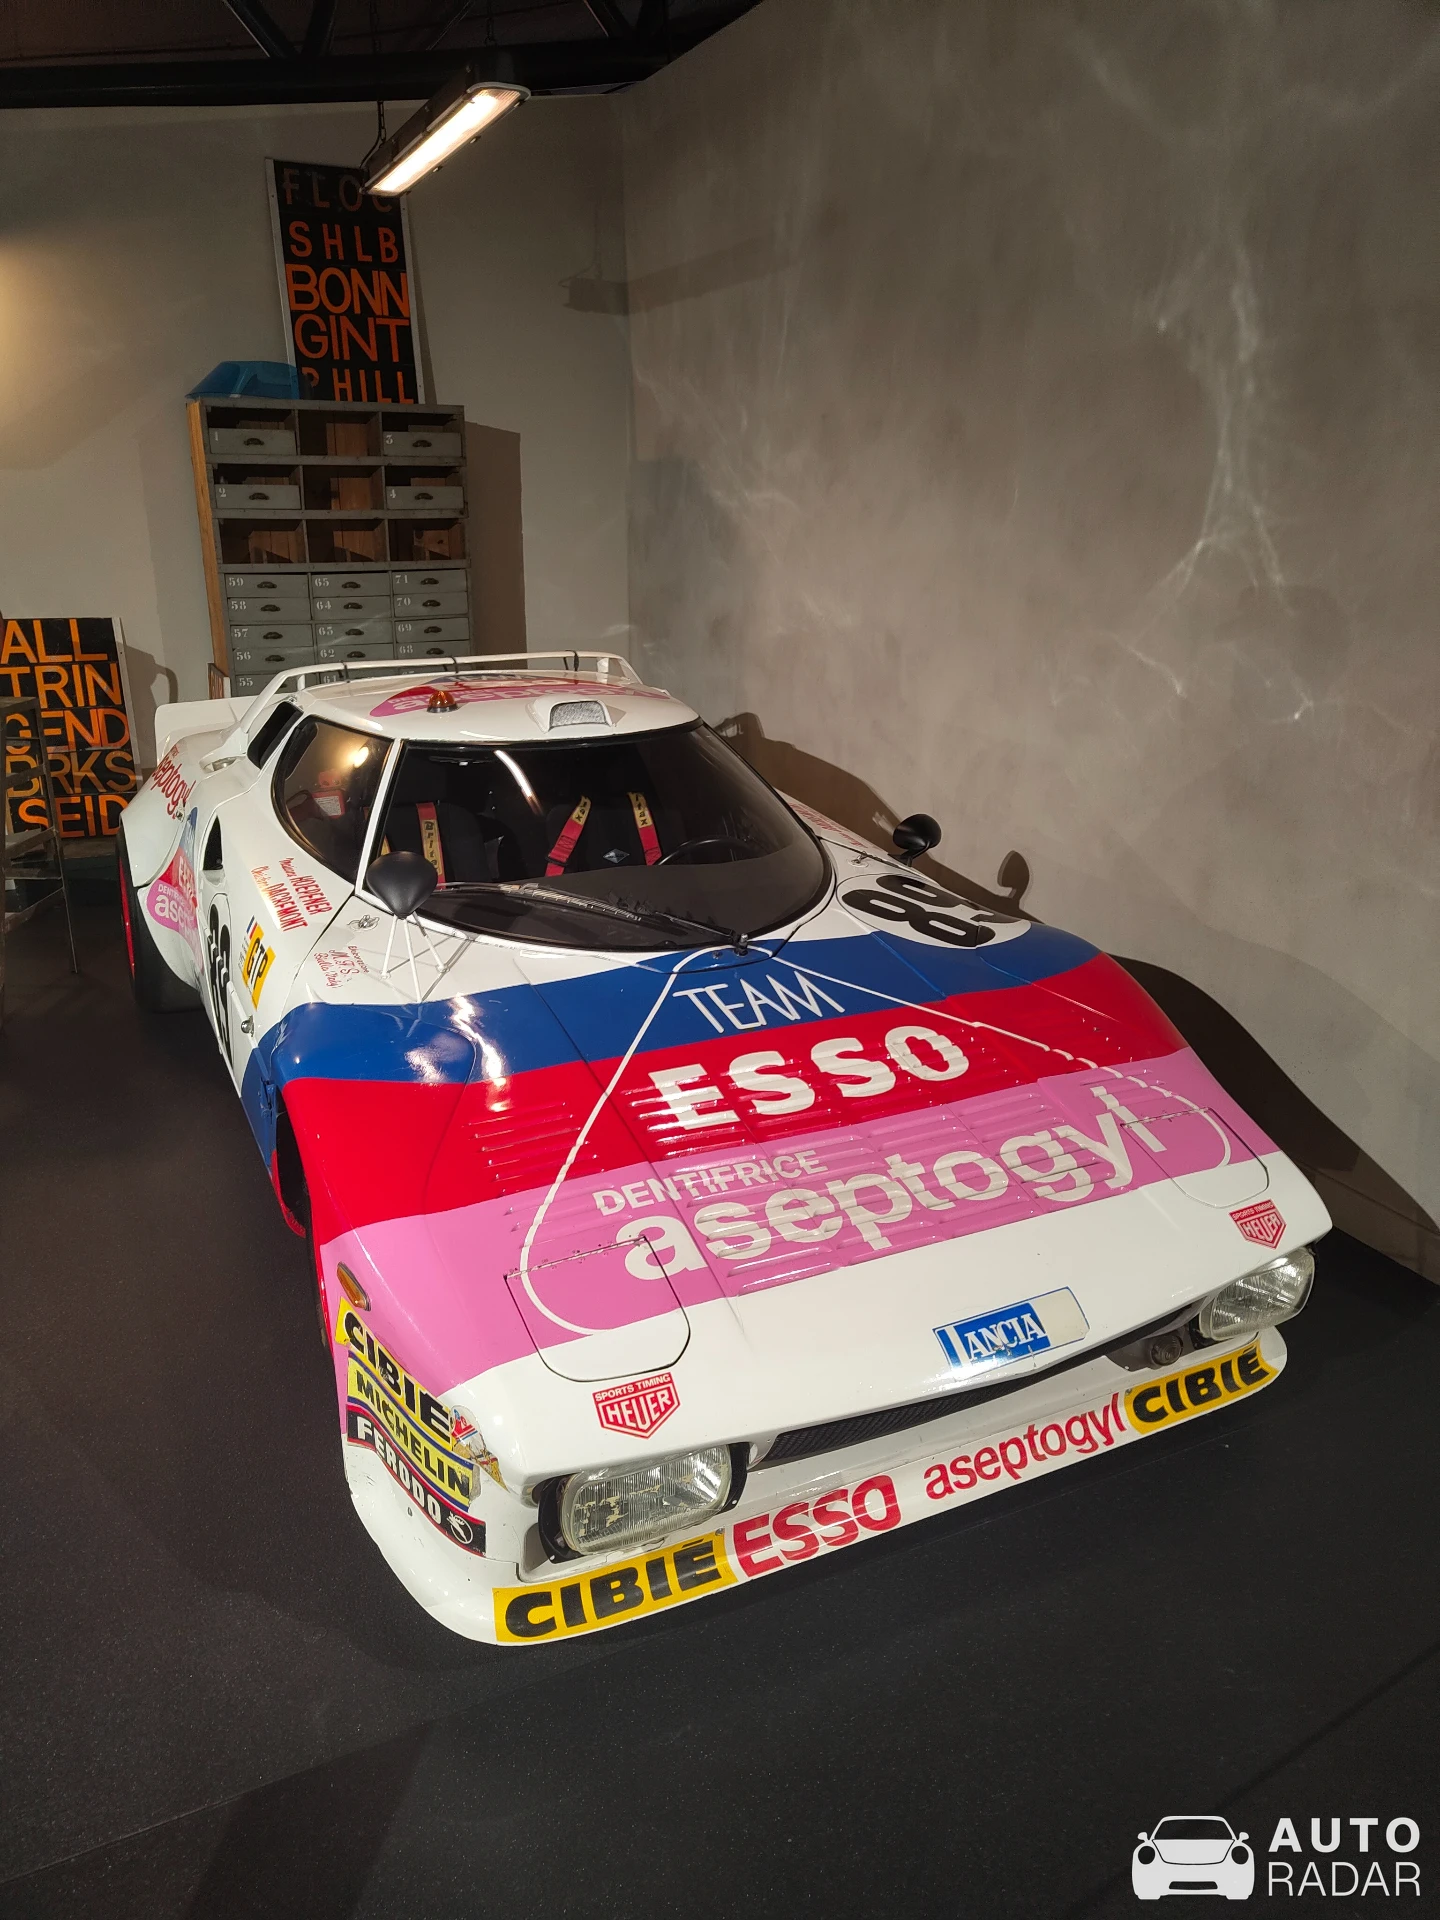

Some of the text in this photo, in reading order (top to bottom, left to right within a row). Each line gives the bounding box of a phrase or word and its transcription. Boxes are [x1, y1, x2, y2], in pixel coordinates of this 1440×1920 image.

[288, 220, 399, 263] SHLB
[285, 263, 410, 318] BONN
[294, 313, 410, 363] GINT
[385, 434, 393, 445] 3
[218, 487, 227, 498] 2
[389, 488, 396, 499] 4
[228, 576, 244, 587] 59
[231, 600, 247, 611] 58
[316, 600, 332, 611] 64
[0, 618, 108, 664] ALL
[234, 628, 248, 638] 57
[236, 651, 251, 662] 56
[0, 662, 124, 709] TRIN
[239, 677, 253, 687] 55
[6, 707, 130, 755] GEND
[18, 795, 130, 838] SEID
[672, 969, 846, 1035] TEAM
[648, 1025, 970, 1131] ESSO
[592, 1149, 828, 1218] DENTIFRICE
[615, 1085, 1168, 1282] aseptogyl
[1242, 1212, 1281, 1243] HEUER
[594, 1373, 672, 1403] SPORTS TIMING
[356, 1369, 473, 1498] MICHELIN
[605, 1389, 672, 1437] HEUER
[357, 1416, 442, 1525] FERODO
[733, 1474, 901, 1578] ESSO
[923, 1392, 1128, 1500] aseptogyl
